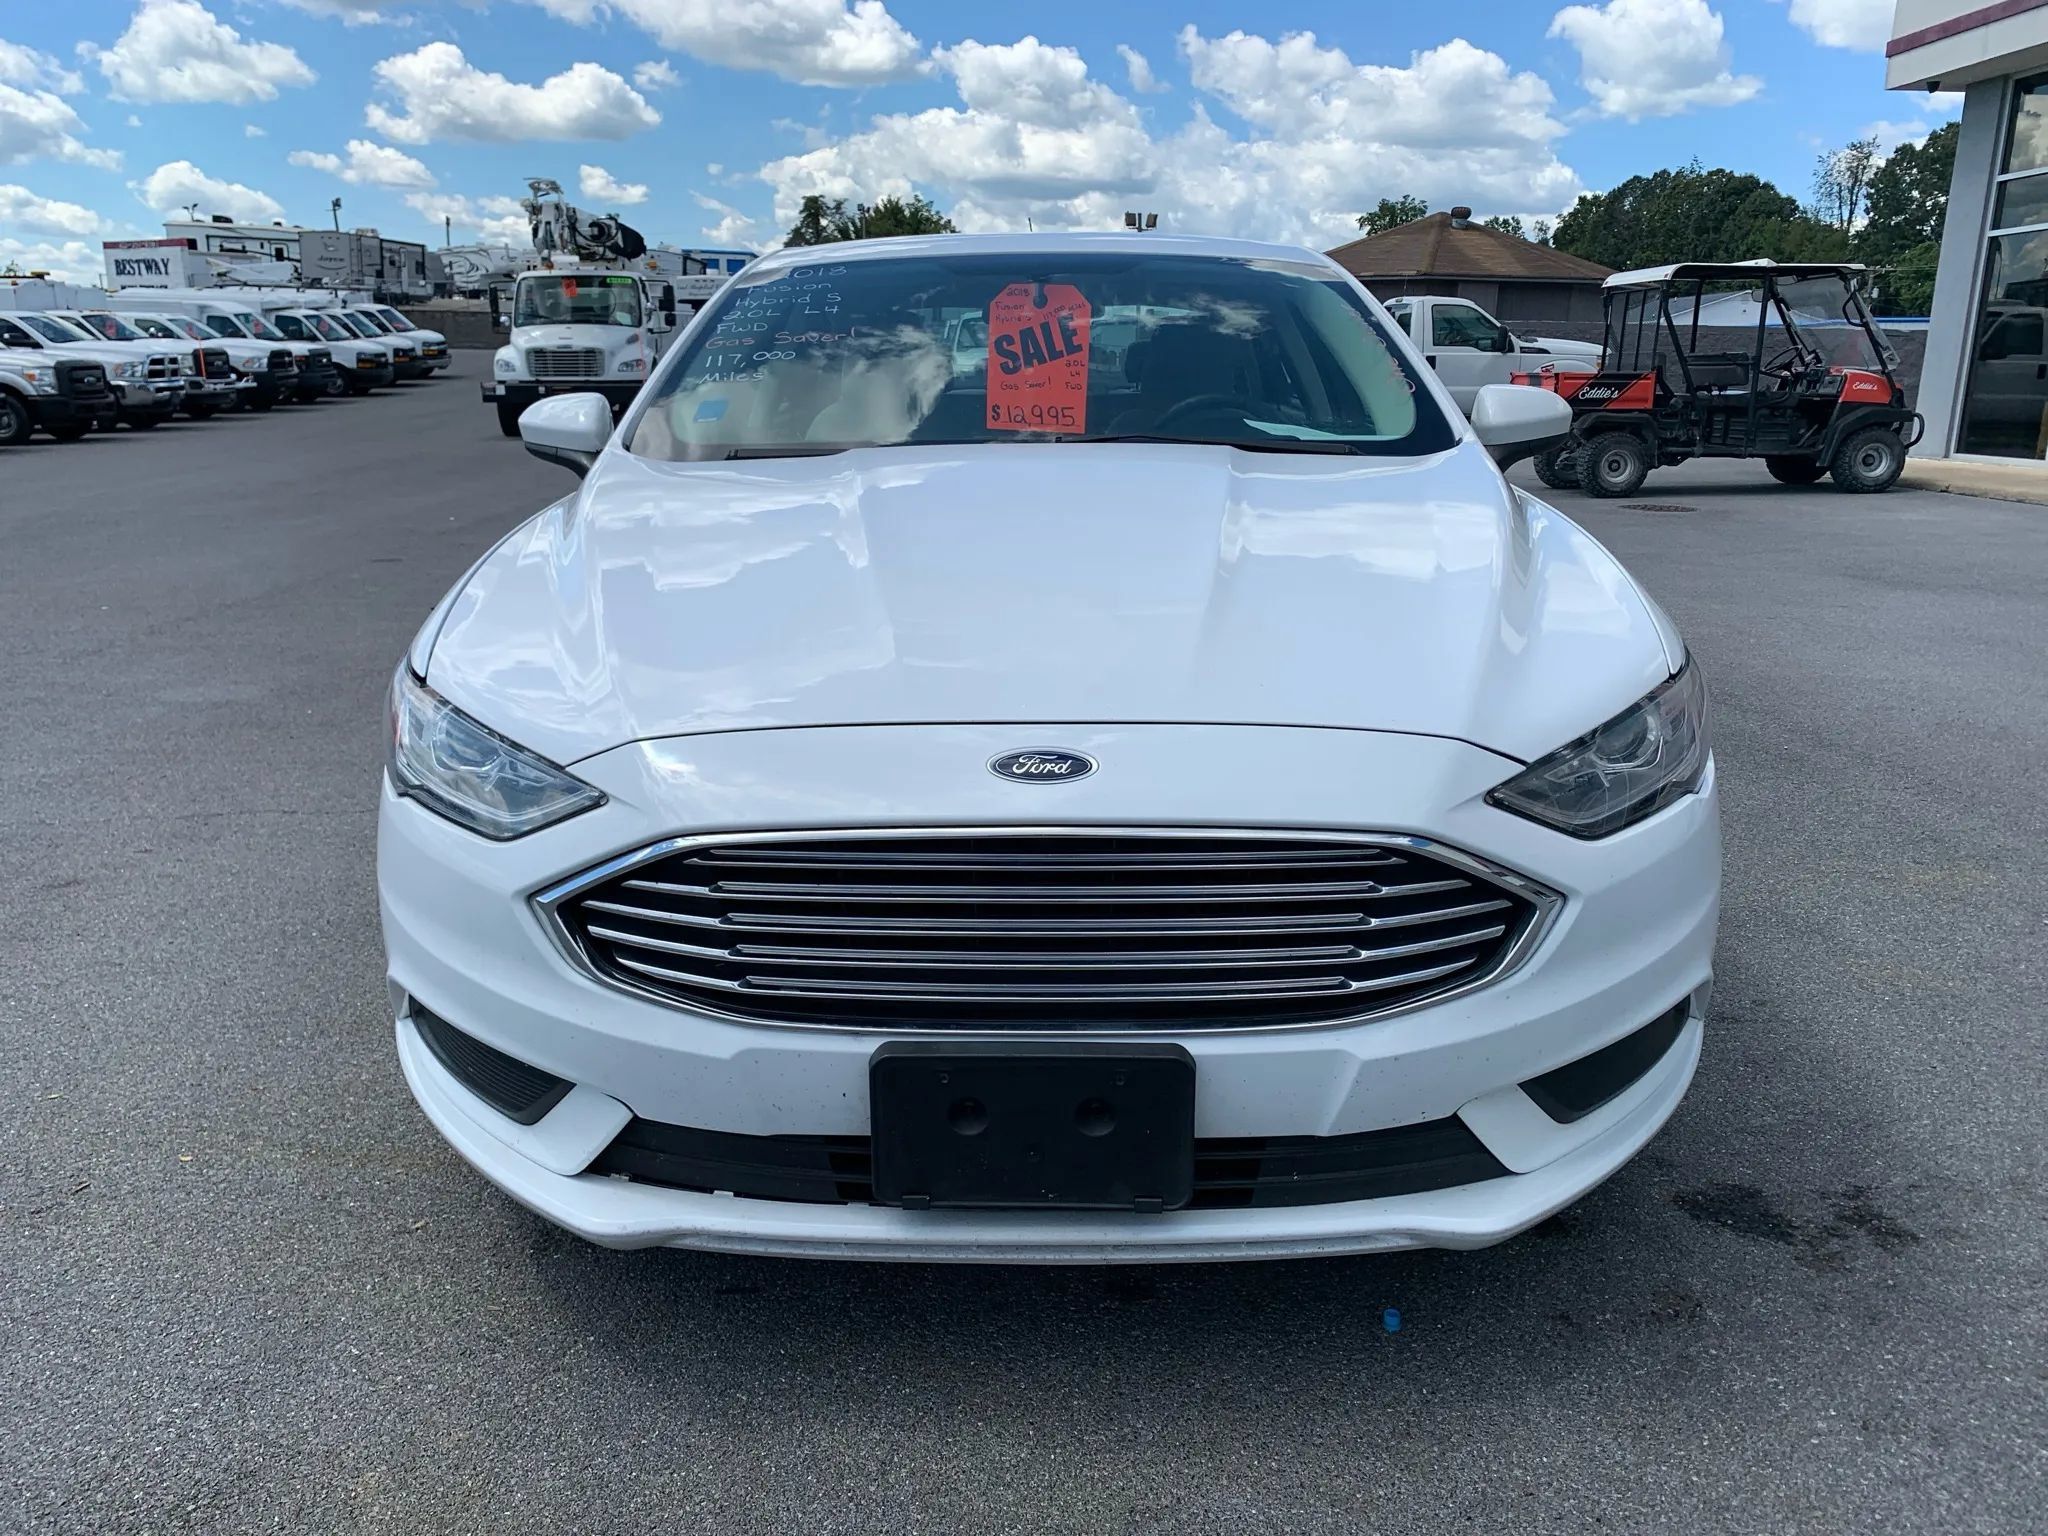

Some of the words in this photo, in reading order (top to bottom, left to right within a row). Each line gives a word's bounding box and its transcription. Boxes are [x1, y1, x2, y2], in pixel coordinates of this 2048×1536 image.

[114, 258, 170, 276] BESTWAY
[784, 265, 848, 280] 018
[736, 293, 812, 308] Hybrid
[826, 292, 842, 303] S
[722, 309, 781, 320] 2.0L
[717, 322, 768, 334] FWD
[705, 336, 755, 349] Gas
[994, 313, 1084, 375] SALE
[705, 351, 796, 368] 117,000
[698, 371, 765, 385] Miles
[1000, 380, 1020, 390] Gas
[1578, 386, 1619, 400] Eddie's
[1852, 381, 1878, 391] Eddie's
[1012, 754, 1073, 774] Ford
